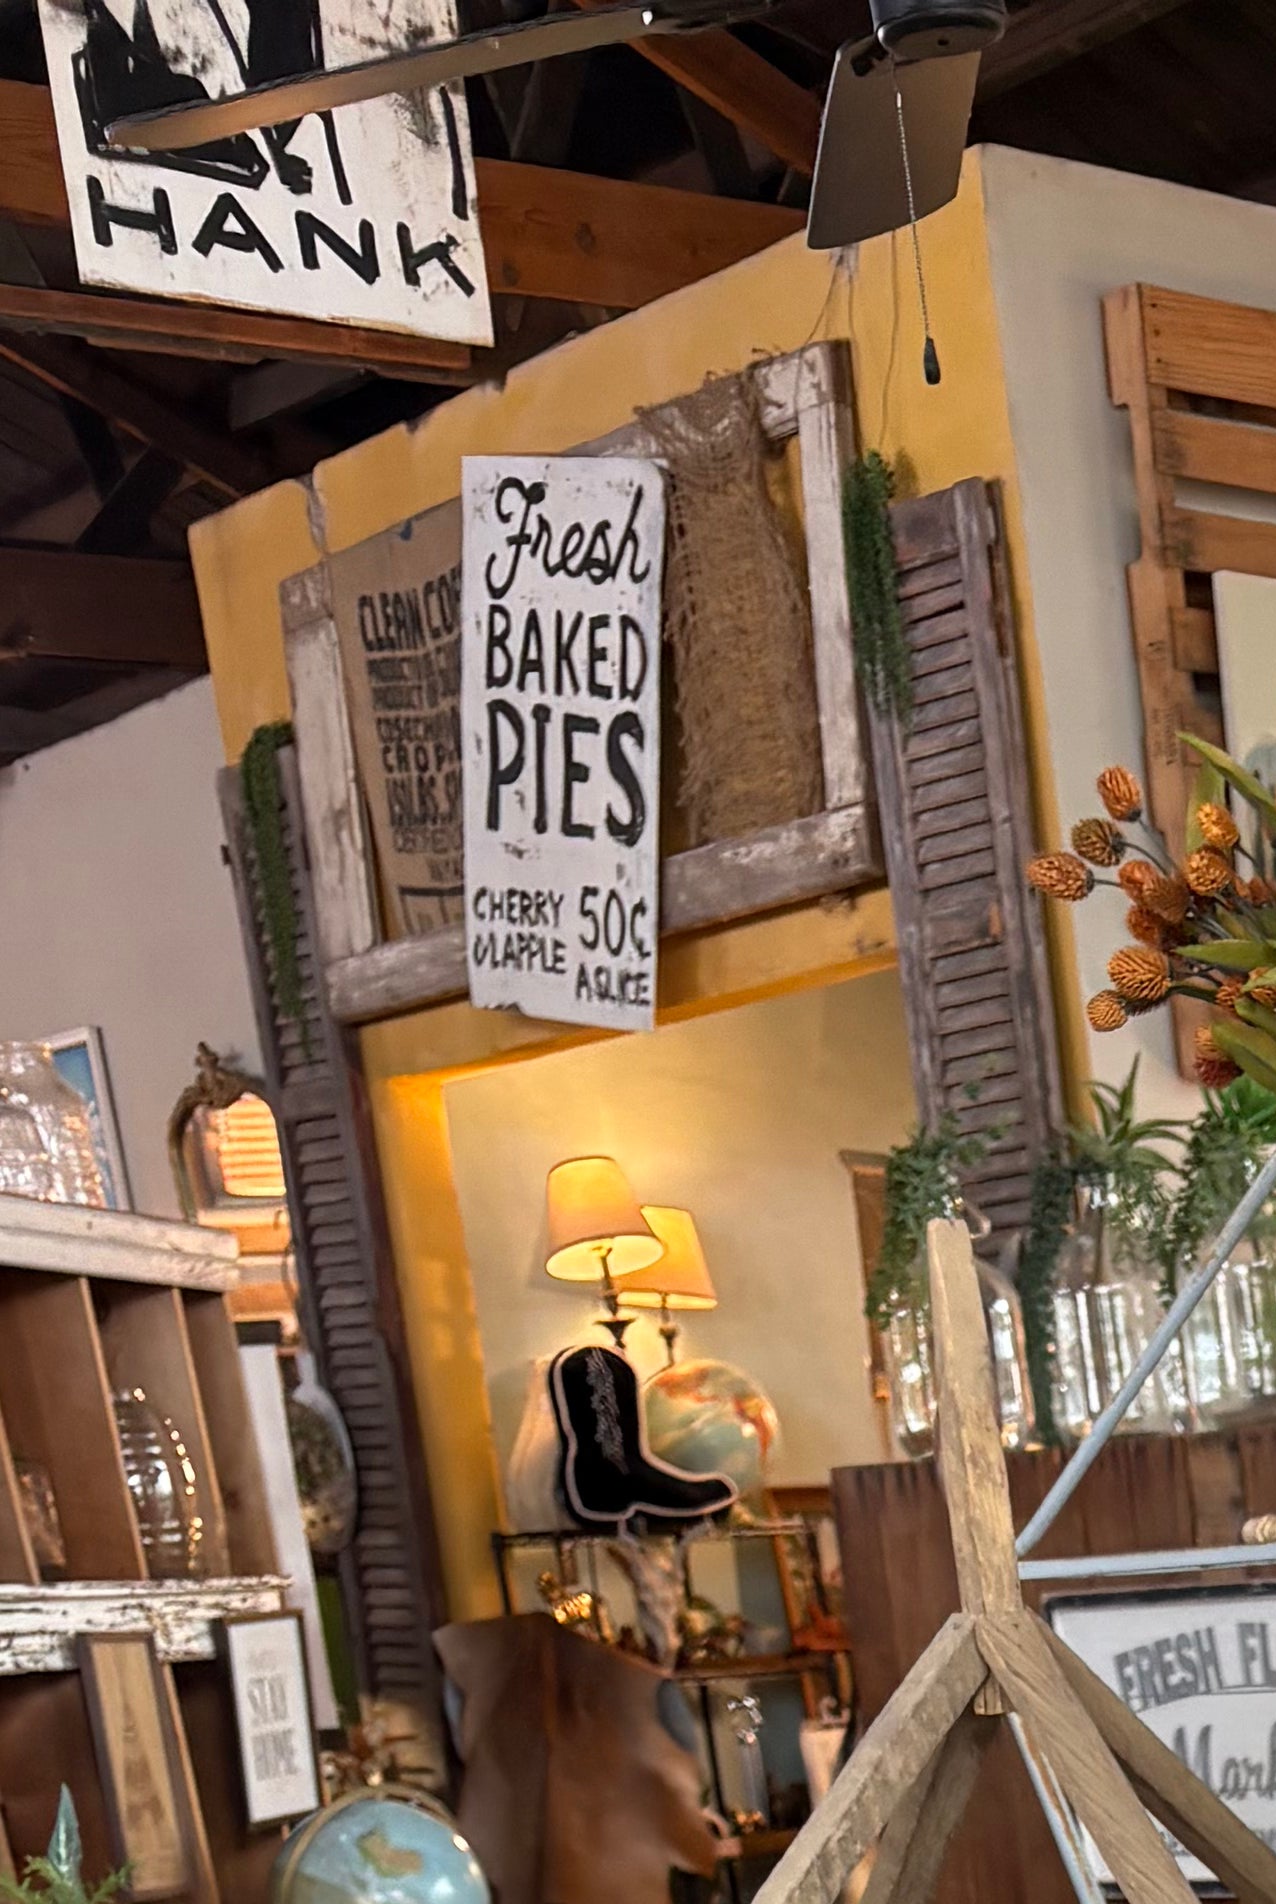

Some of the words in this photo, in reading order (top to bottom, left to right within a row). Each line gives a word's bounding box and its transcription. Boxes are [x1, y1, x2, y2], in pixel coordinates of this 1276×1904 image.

[87, 175, 475, 298] HANK
[486, 477, 650, 600] Fresh
[486, 604, 648, 702] BAKED
[486, 698, 645, 848] PIES
[473, 886, 564, 928] CHERRY
[1113, 1625, 1223, 1714] FRESH
